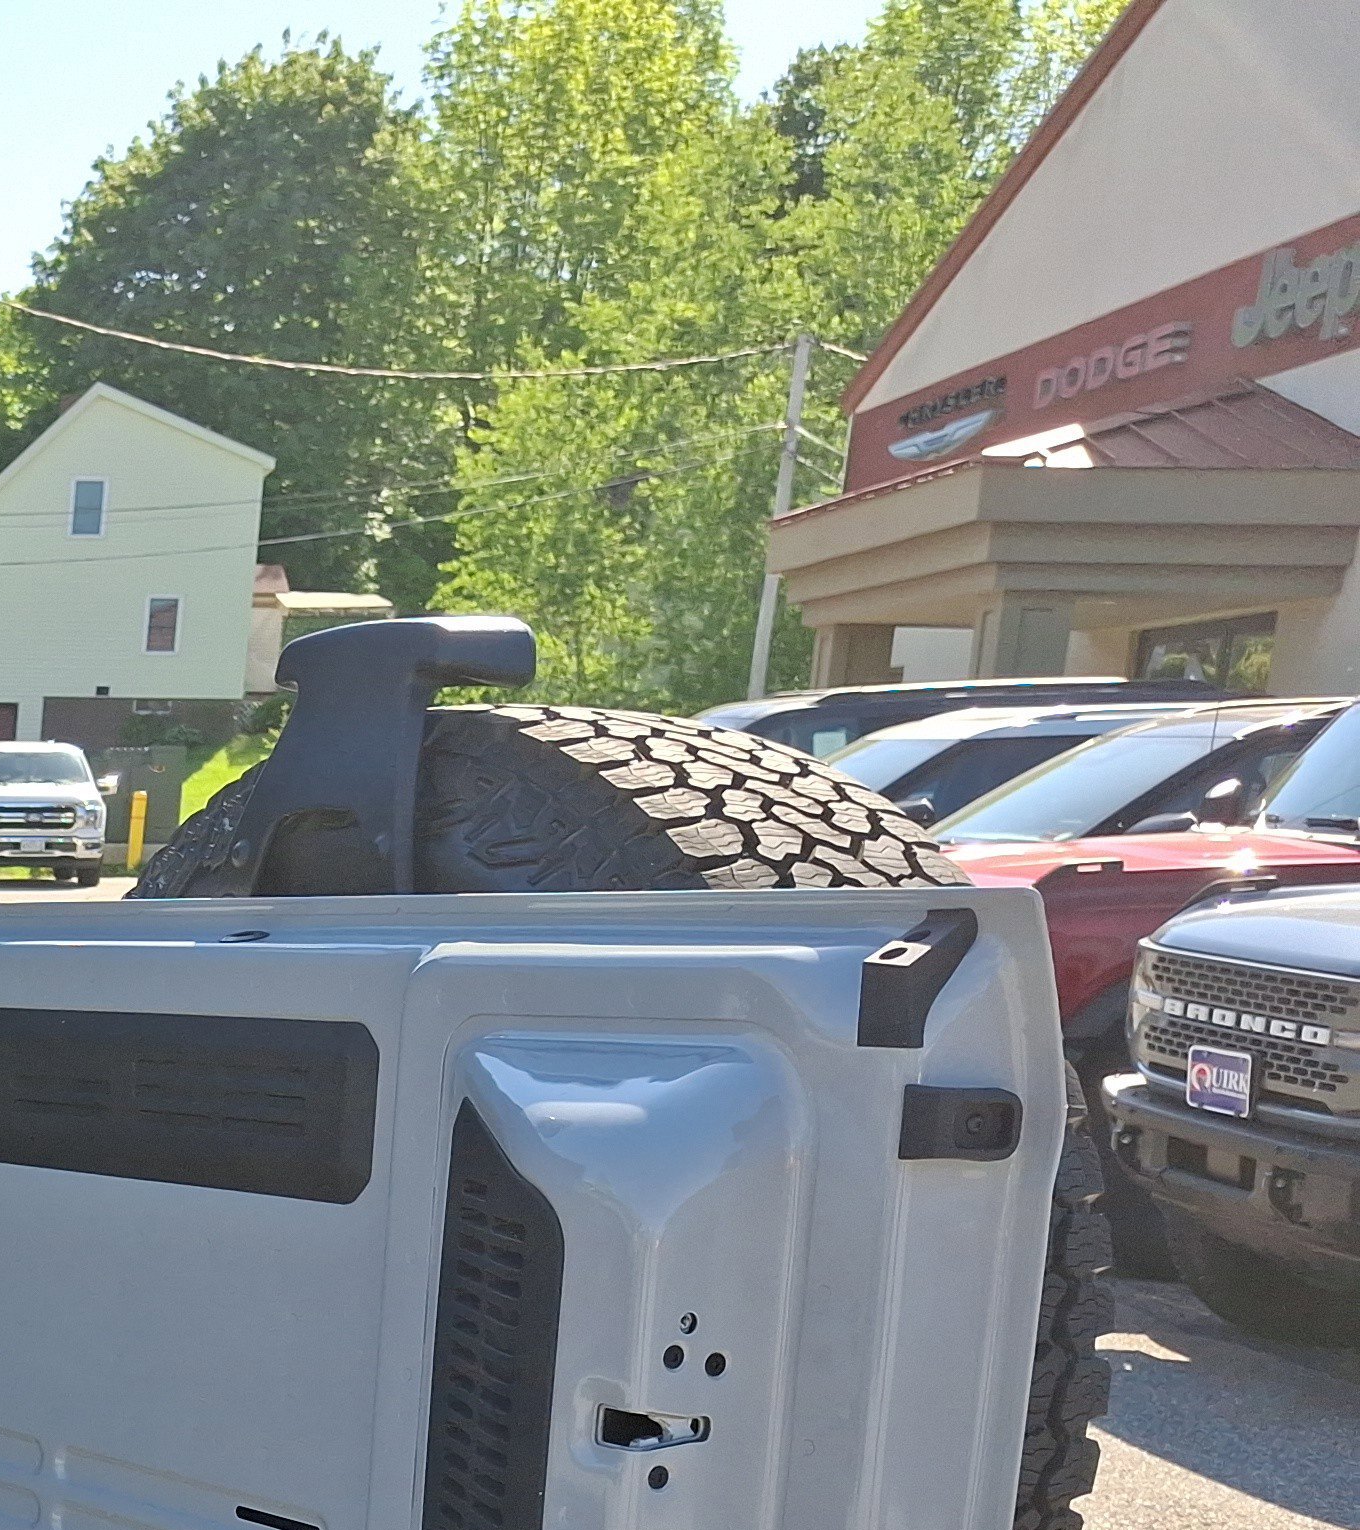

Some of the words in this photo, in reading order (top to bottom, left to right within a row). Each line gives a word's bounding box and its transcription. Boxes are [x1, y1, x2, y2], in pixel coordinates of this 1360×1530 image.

[1231, 245, 1360, 348] Jeep
[1033, 321, 1193, 409] DODGE
[1164, 998, 1331, 1045] BRONCO
[1191, 1062, 1249, 1095] QUIRK
